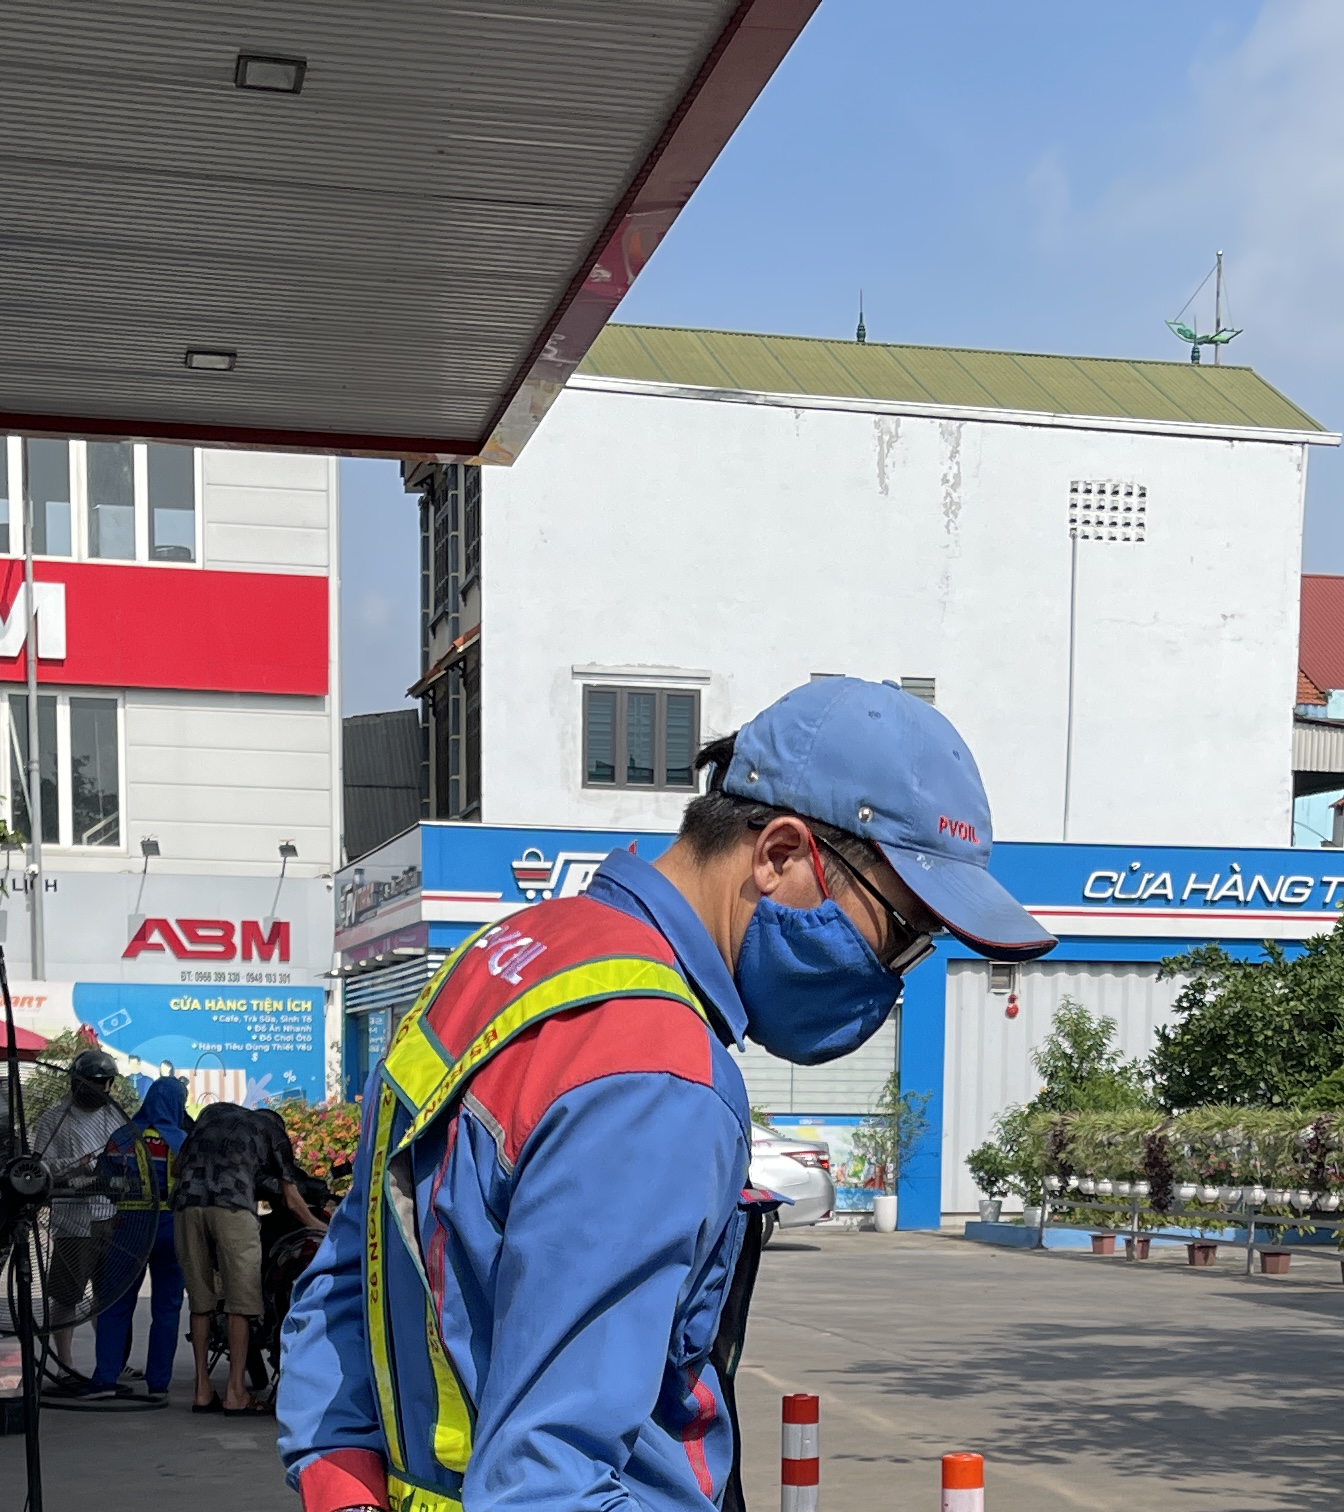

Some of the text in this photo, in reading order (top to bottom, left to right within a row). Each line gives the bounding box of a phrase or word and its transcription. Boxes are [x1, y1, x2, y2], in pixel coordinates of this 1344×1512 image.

[938, 815, 981, 845] PVOIL
[1083, 862, 1174, 901] CỬA
[1182, 862, 1314, 903] HÀNG
[121, 918, 291, 962] ABM
[170, 994, 313, 1014] CỬA HÀNG TIỆN ÍCH
